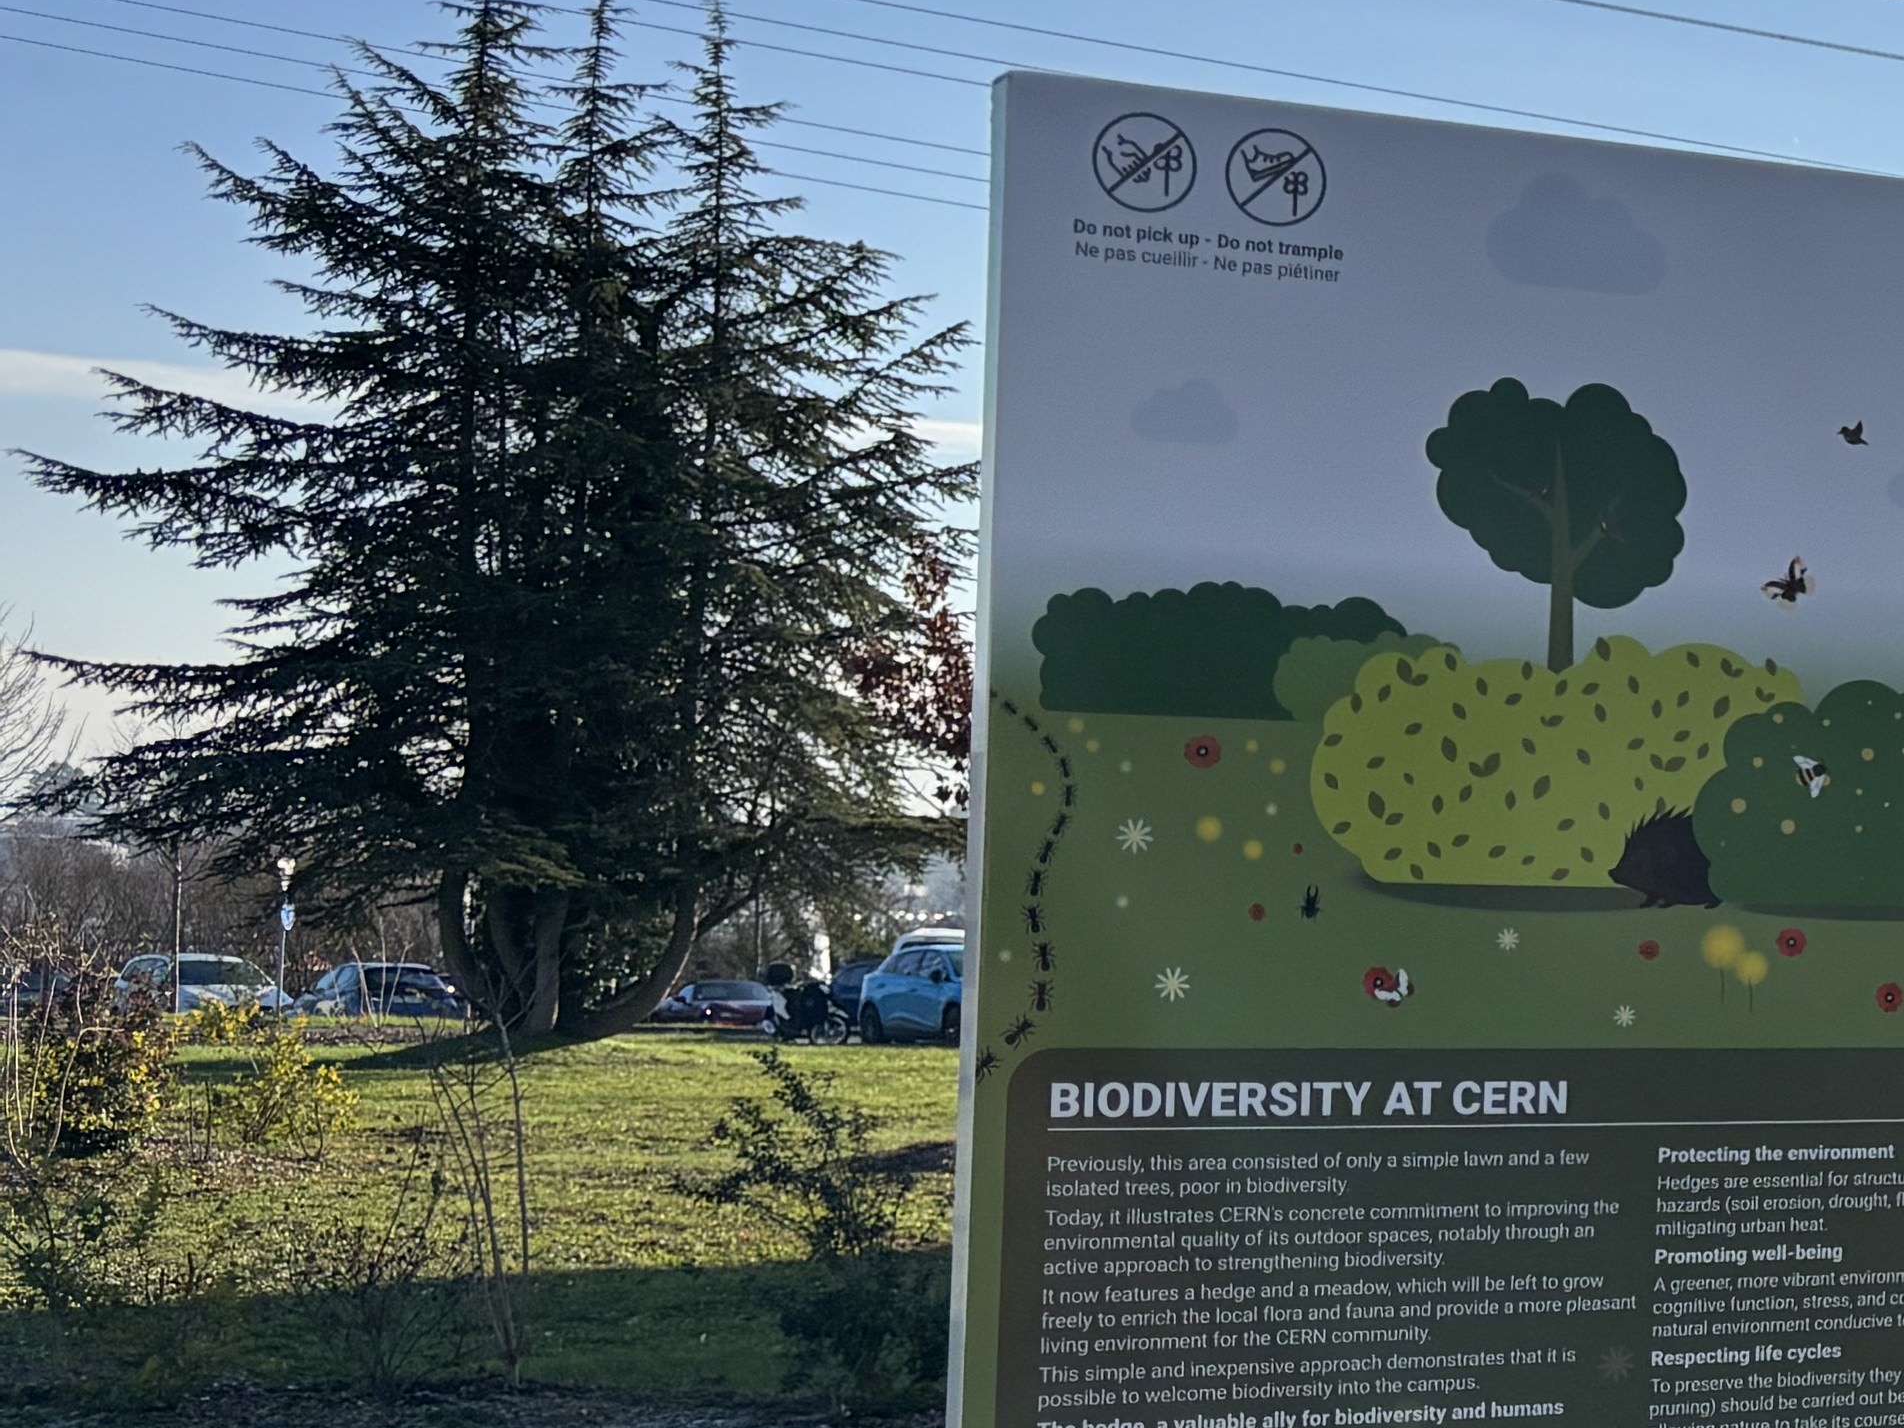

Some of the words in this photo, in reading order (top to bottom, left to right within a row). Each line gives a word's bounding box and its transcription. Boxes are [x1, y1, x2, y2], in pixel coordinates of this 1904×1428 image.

[1073, 218, 1097, 235] Do
[1103, 225, 1131, 239] not
[1137, 226, 1173, 243] pick
[1178, 233, 1200, 249] up
[1218, 234, 1240, 250] Do
[1245, 239, 1273, 254] not
[1279, 241, 1344, 262] trample
[1075, 241, 1099, 258] Ne
[1104, 247, 1136, 262] pas
[1141, 251, 1198, 268] cueillir
[1214, 255, 1237, 272] Ne
[1242, 261, 1272, 276] pas
[1278, 263, 1340, 282] piétiner
[1050, 1081, 1372, 1118] BIODIVERSITY
[1383, 1081, 1442, 1115] AT
[1453, 1080, 1567, 1115] CERN
[1048, 1155, 1144, 1175] Previously,
[1150, 1154, 1183, 1171] this
[1188, 1158, 1226, 1171] area
[1232, 1153, 1318, 1169] consisted
[1324, 1152, 1342, 1168] of
[1346, 1152, 1382, 1172] only
[1387, 1156, 1397, 1168] a
[1403, 1151, 1459, 1170] simple
[1464, 1151, 1503, 1166] lawn
[1508, 1150, 1539, 1166] and
[1544, 1153, 1554, 1165] a
[1560, 1149, 1589, 1165] few
[1658, 1146, 1750, 1165] Protecting
[1755, 1145, 1783, 1161] the
[1787, 1144, 1894, 1160] environment
[1047, 1180, 1119, 1197] isolated
[1125, 1181, 1174, 1197] trees,
[1180, 1182, 1221, 1198] poor
[1226, 1178, 1241, 1194] in
[1247, 1176, 1350, 1196] biodiversity.
[1657, 1174, 1719, 1193] Hedges
[1724, 1177, 1749, 1189] are
[1753, 1171, 1823, 1188] essential
[1828, 1171, 1848, 1186] for
[1045, 1209, 1103, 1229] Today,
[1110, 1210, 1120, 1225] it
[1126, 1208, 1214, 1224] illustrates
[1220, 1206, 1283, 1222] CERN's
[1289, 1206, 1365, 1221] concrete
[1370, 1203, 1479, 1220] commitment
[1485, 1203, 1501, 1217] to
[1507, 1200, 1589, 1220] improving
[1594, 1200, 1619, 1215] the
[1044, 1231, 1175, 1250] environmental
[1181, 1231, 1240, 1251] quality
[1245, 1229, 1263, 1246] of
[1269, 1230, 1289, 1245] its
[1294, 1228, 1363, 1245] outdoor
[1368, 1230, 1432, 1247] spaces,
[1438, 1225, 1500, 1244] notably
[1505, 1223, 1569, 1242] through
[1574, 1226, 1594, 1238] an
[1656, 1220, 1736, 1239] mitigating
[1741, 1218, 1785, 1233] urban
[1790, 1217, 1827, 1231] heat.
[1043, 1259, 1098, 1275] active
[1104, 1255, 1189, 1277] approach
[1195, 1257, 1212, 1271] to
[1218, 1253, 1339, 1274] strengthening
[1345, 1250, 1444, 1268] biodiversity.
[1655, 1247, 1747, 1266] Promoting
[1752, 1244, 1843, 1262] well-being
[1041, 1337, 1088, 1356] living
[1094, 1334, 1207, 1352] environment
[1214, 1331, 1238, 1347] for
[1244, 1330, 1271, 1346] the
[1276, 1329, 1326, 1345] CERN
[1332, 1325, 1430, 1344] community.
[1651, 1347, 1750, 1369] Respecting
[1755, 1344, 1782, 1361] life
[1787, 1343, 1841, 1363] cycles
[1302, 1409, 1330, 1427] for
[1335, 1405, 1447, 1425] biodiversity
[1452, 1401, 1486, 1420] and
[1491, 1401, 1564, 1418] humans
